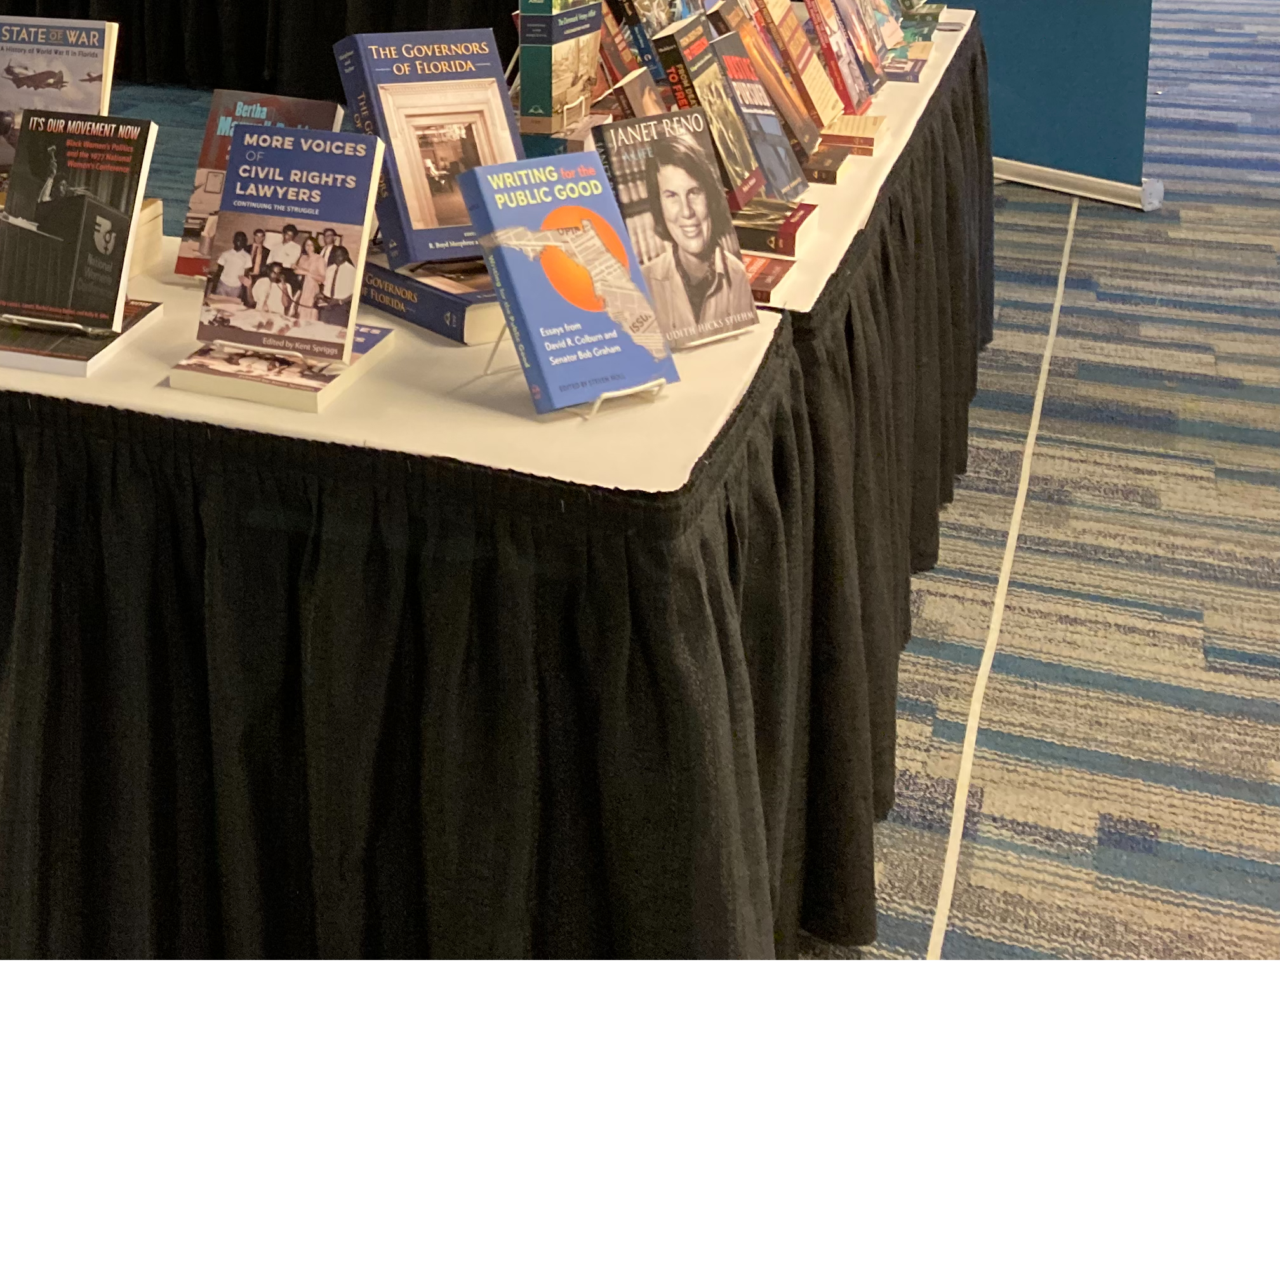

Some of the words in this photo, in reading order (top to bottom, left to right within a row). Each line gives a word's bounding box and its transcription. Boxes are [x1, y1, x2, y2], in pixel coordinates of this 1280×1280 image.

[1, 26, 47, 43] STATE
[49, 31, 63, 42] OF
[66, 30, 100, 46] WAR
[6, 46, 26, 55] History
[78, 50, 98, 59] Florida
[368, 45, 400, 60] THE
[401, 41, 489, 59] GOVERNORS
[393, 62, 413, 76] OF
[415, 60, 476, 75] FLORIDA
[235, 101, 267, 119] Bertha
[28, 116, 46, 131] IT'S
[46, 118, 65, 133] OUR
[66, 120, 116, 138] MOVEMENT
[118, 125, 141, 141] NOW
[610, 121, 658, 153] JANET
[662, 113, 704, 137] RENO
[244, 133, 295, 150] MORE
[300, 138, 367, 157] VOICES
[246, 150, 265, 162] OF
[238, 165, 284, 181] CIVIL
[289, 170, 357, 189] RIGHTS
[487, 166, 558, 190] WRITING
[561, 167, 576, 179] for
[578, 165, 596, 177] the
[235, 182, 322, 203] LAWYERS
[493, 184, 552, 210] PUBLIC
[554, 179, 602, 199] GOOD
[233, 199, 272, 210] CONTINUING
[273, 204, 285, 212] THE
[286, 205, 320, 215] STRUGGLE
[365, 274, 418, 303] GOVERNORS
[370, 289, 407, 313] FLORIDA
[488, 255, 501, 287] Writing
[509, 316, 520, 343] Public
[518, 344, 530, 368] Good
[540, 326, 564, 337] Essays
[565, 323, 582, 332] from
[697, 320, 724, 332] HICKS
[724, 311, 755, 326] STIEHM
[262, 337, 284, 349] Edited
[285, 341, 294, 351] by
[294, 341, 311, 352] Kent
[312, 344, 338, 356] Spriggs
[544, 339, 566, 351] David
[566, 338, 574, 347] R.
[575, 333, 603, 344] Colburn
[604, 329, 618, 339] and
[549, 353, 578, 366] Senator
[578, 350, 593, 360] Bob
[593, 345, 621, 357] Graham
